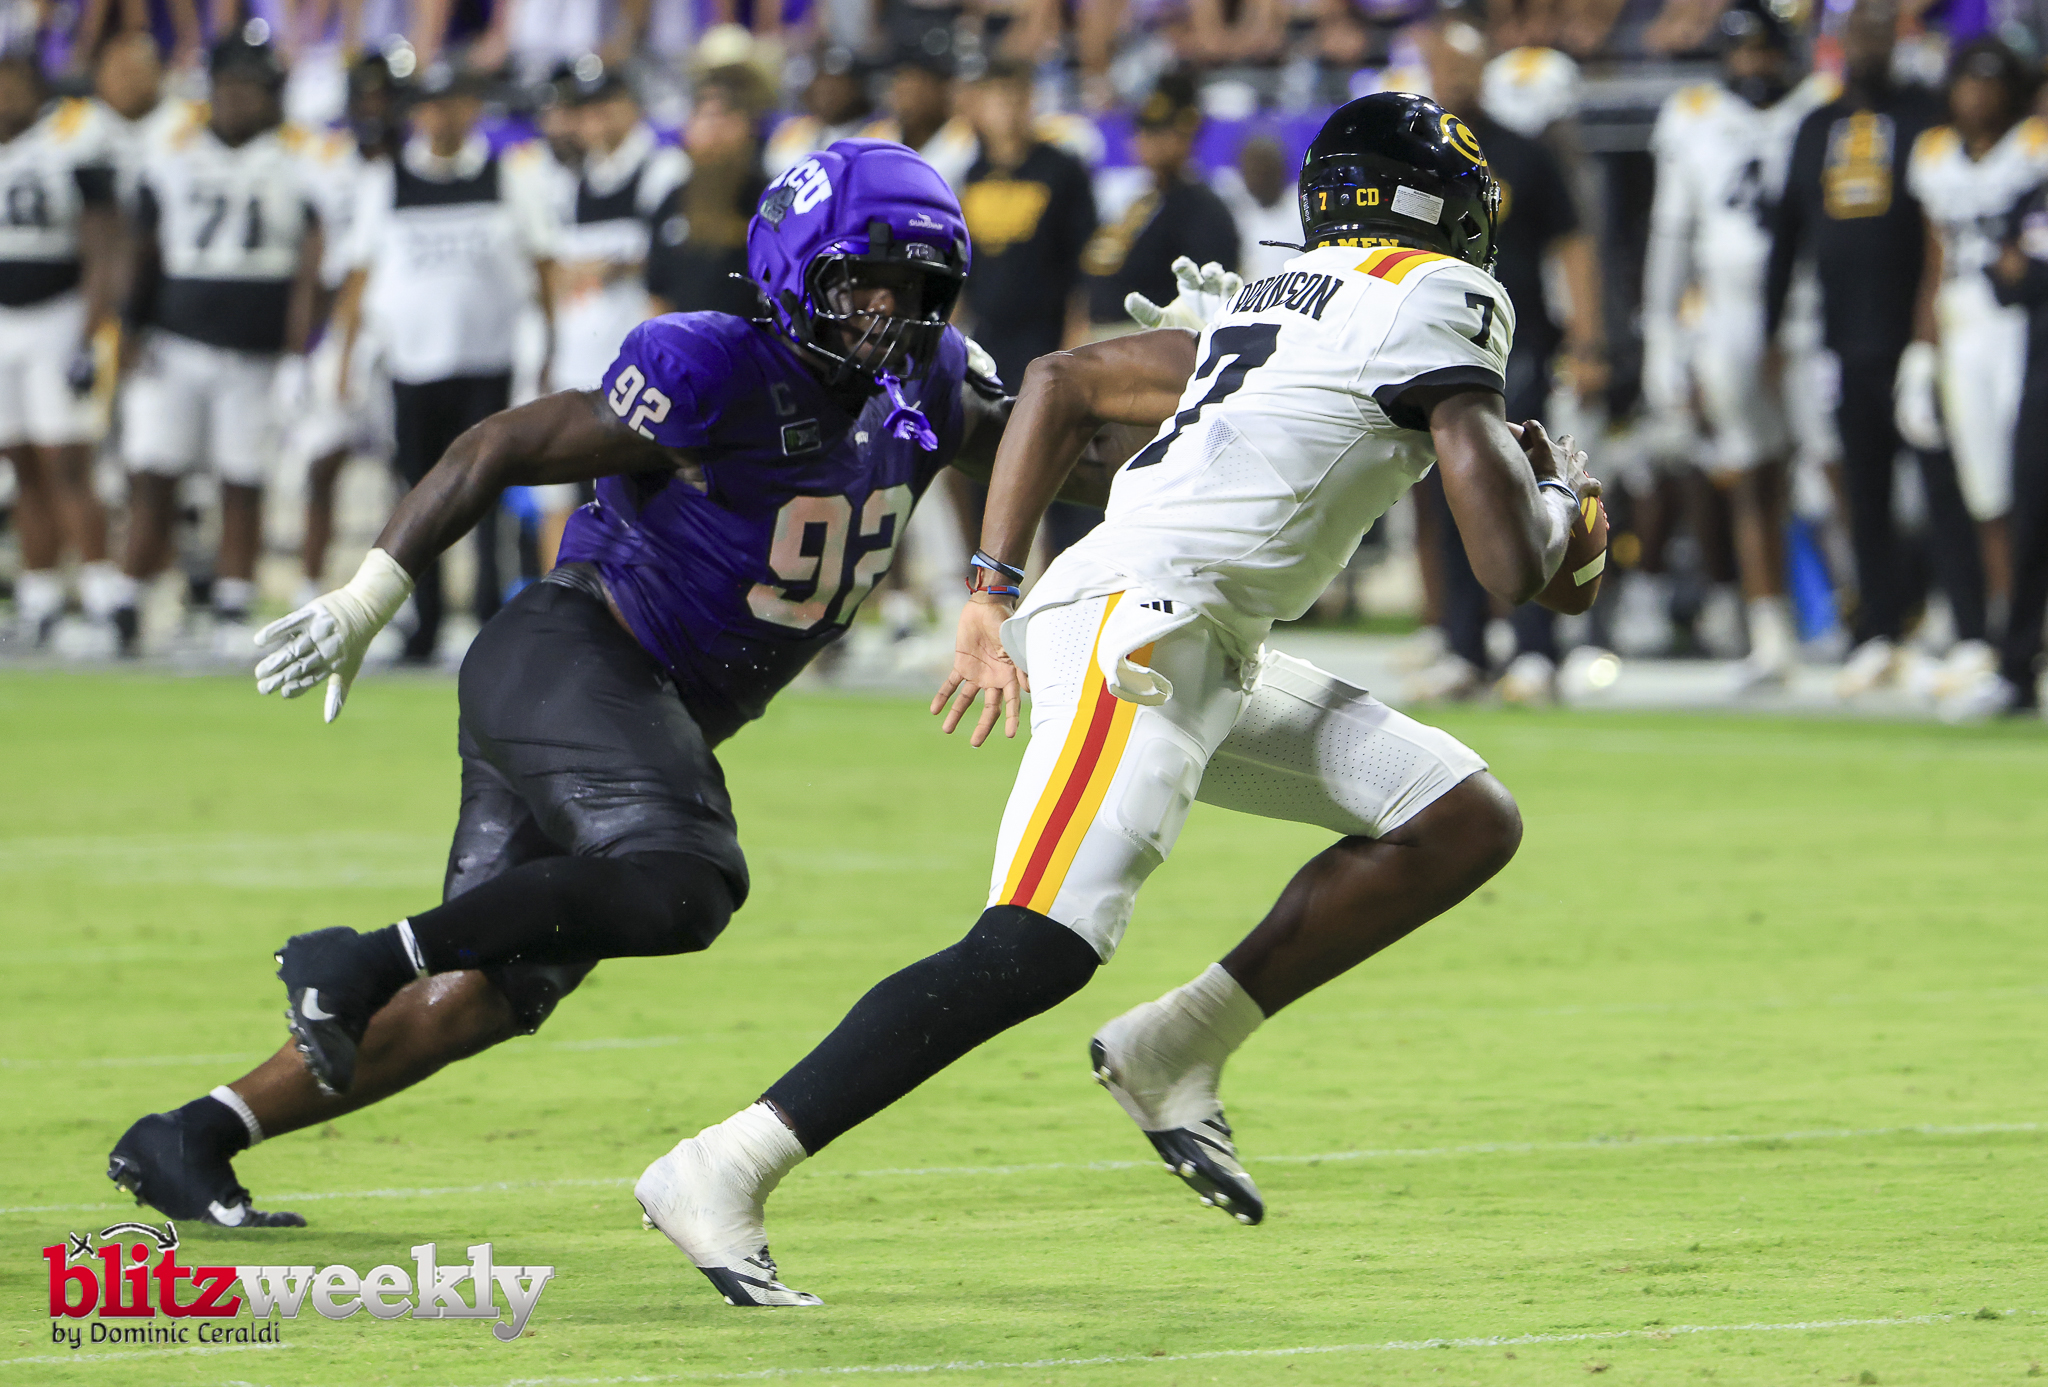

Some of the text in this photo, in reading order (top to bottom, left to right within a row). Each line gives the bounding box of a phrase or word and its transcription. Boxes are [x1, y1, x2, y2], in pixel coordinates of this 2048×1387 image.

[1318, 191, 1328, 211] 7
[1355, 187, 1380, 207] CD
[1226, 271, 1345, 321] OBINSON
[1465, 292, 1495, 348] 7
[608, 364, 672, 440] 92
[1126, 322, 1282, 471] 7
[746, 483, 914, 631] 92
